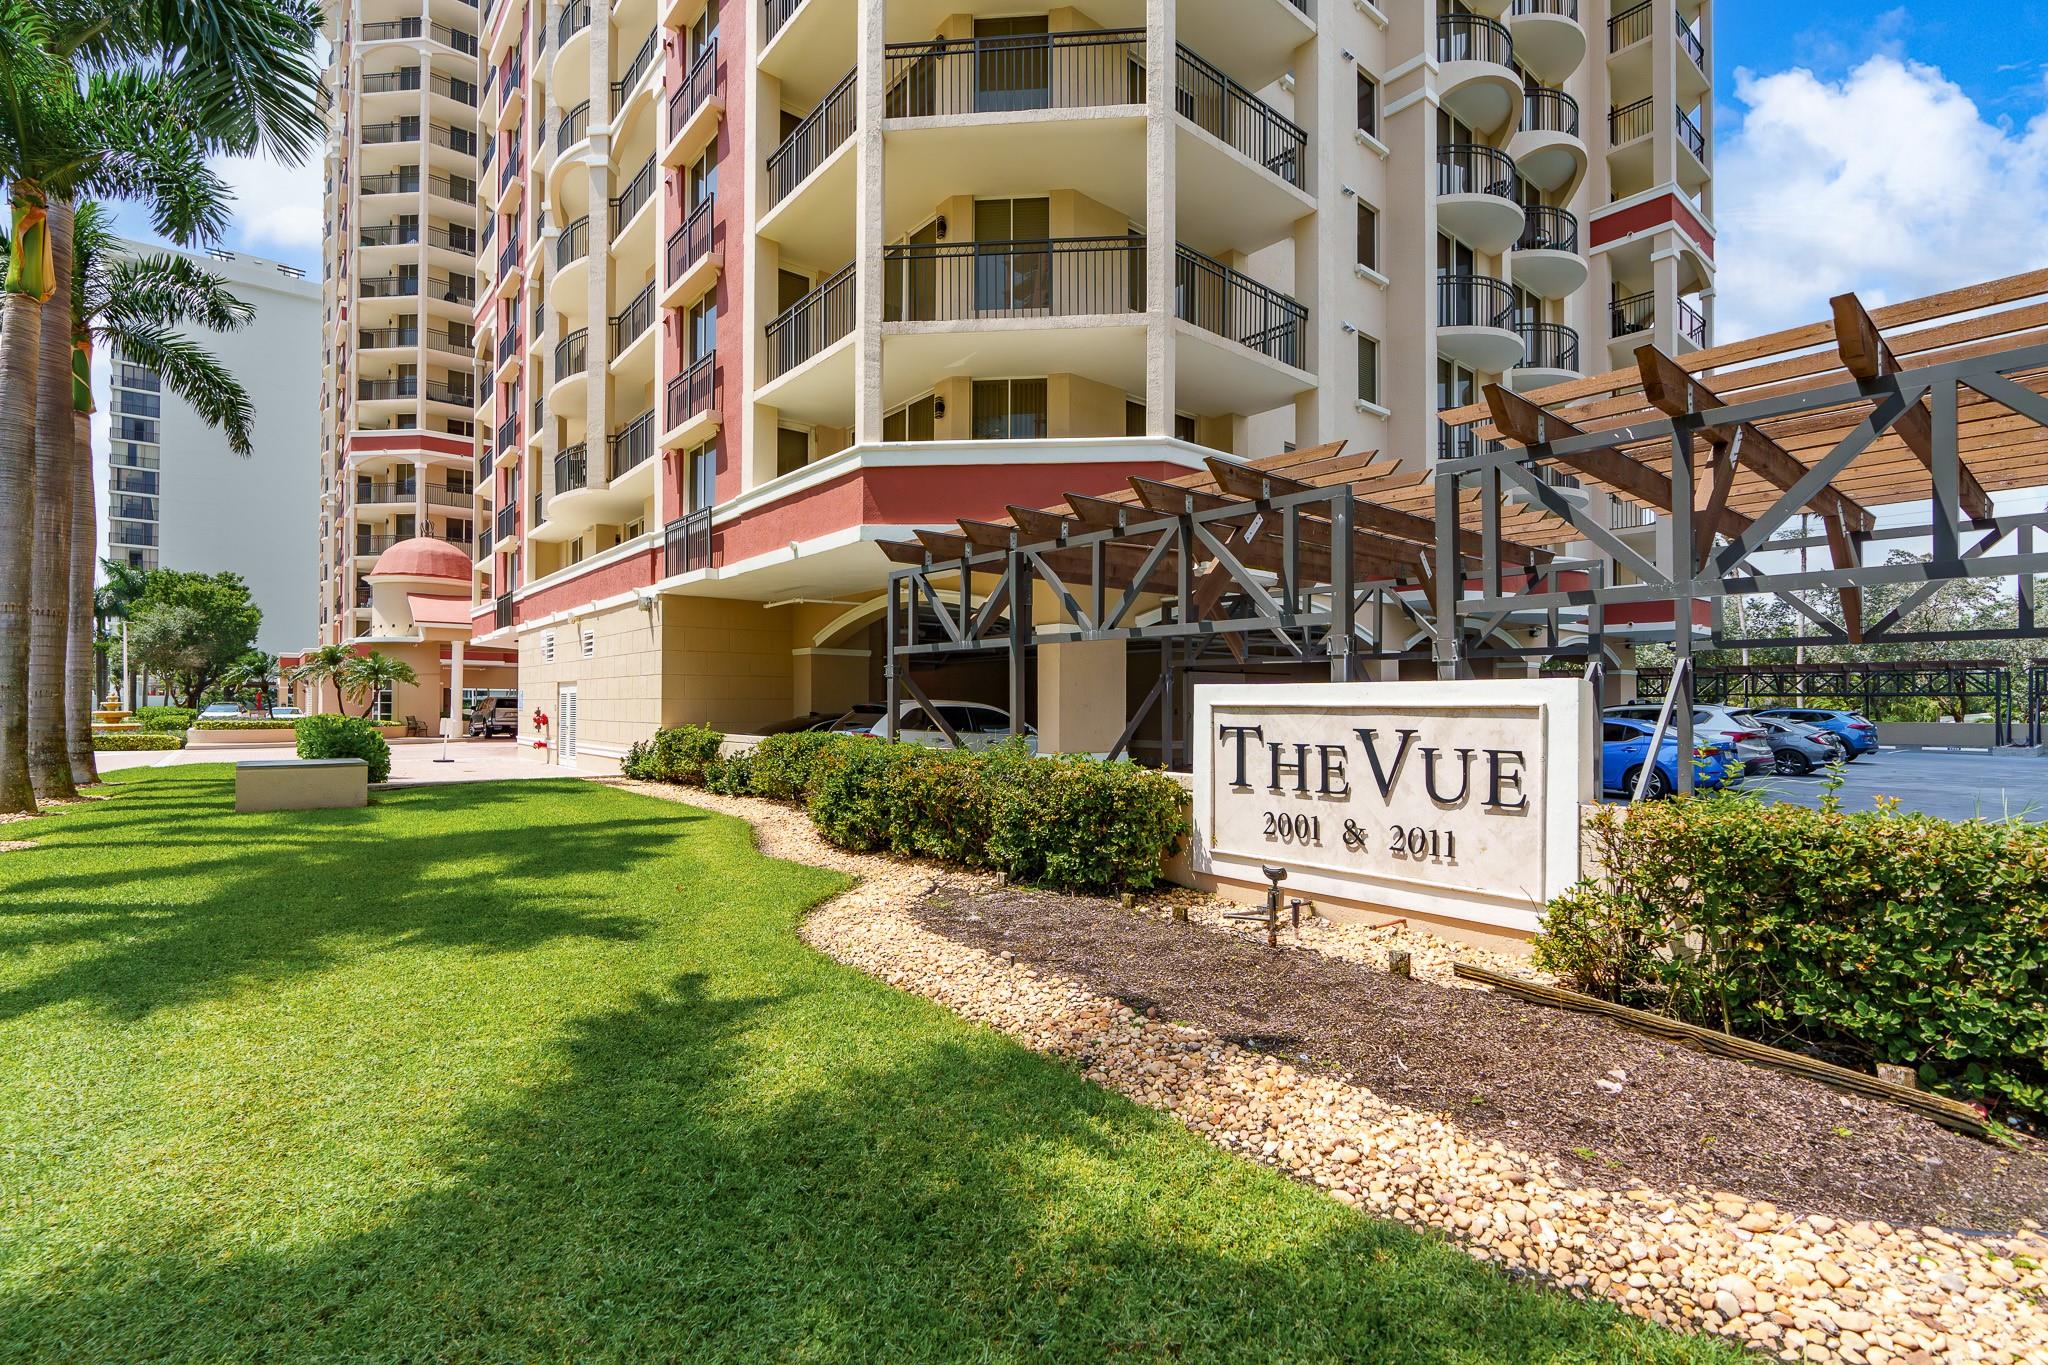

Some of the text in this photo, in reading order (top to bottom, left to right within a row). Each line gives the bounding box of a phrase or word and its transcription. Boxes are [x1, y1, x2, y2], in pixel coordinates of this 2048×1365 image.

[1262, 811, 1455, 859] 2001 & 2011
